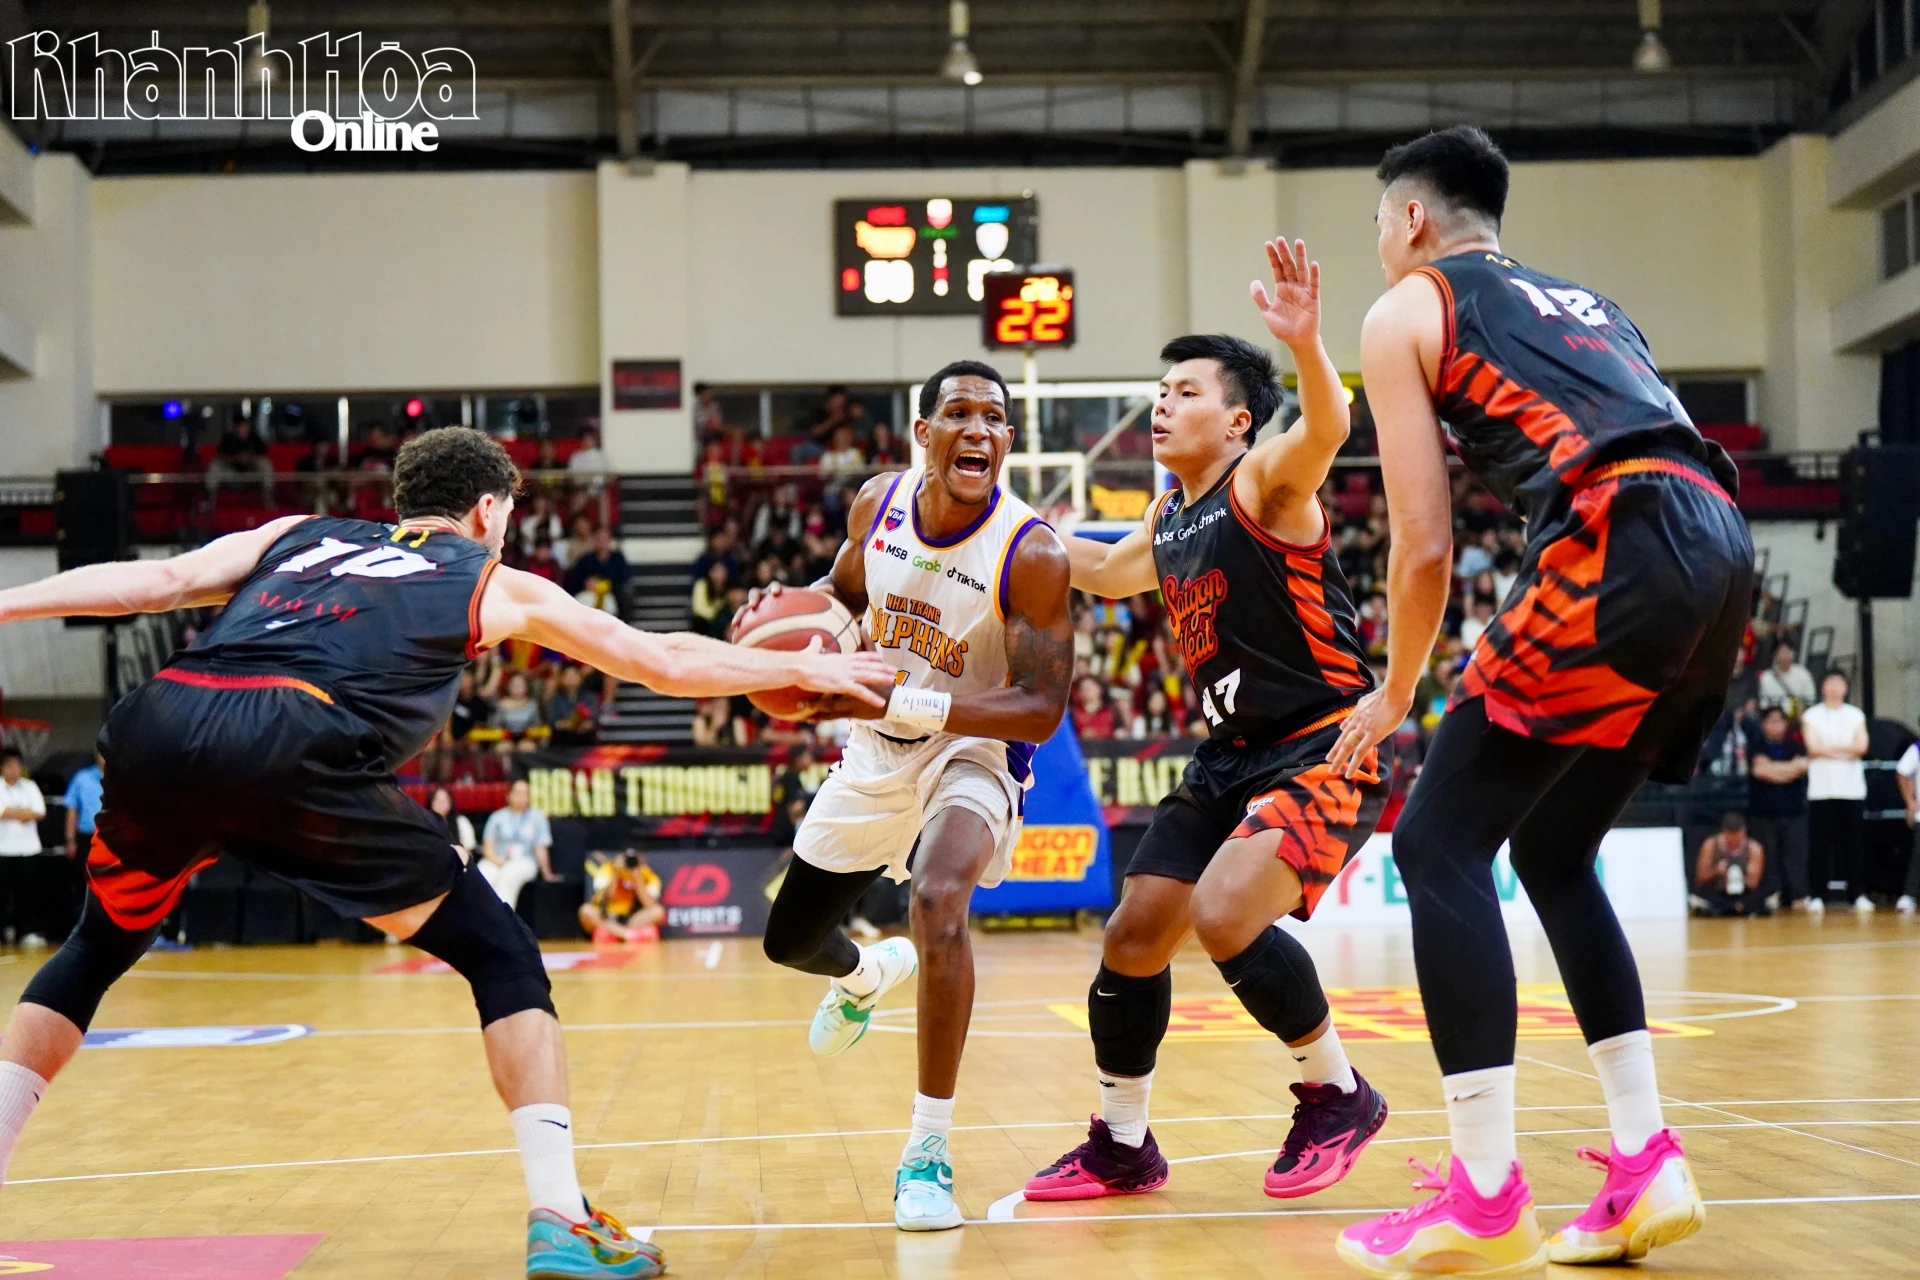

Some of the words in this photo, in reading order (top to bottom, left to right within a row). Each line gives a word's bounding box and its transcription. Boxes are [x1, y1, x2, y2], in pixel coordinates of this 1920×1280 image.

[997, 298, 1070, 342] 22
[1508, 277, 1610, 327] 12
[888, 509, 904, 521] VBA
[274, 536, 437, 577] 10
[885, 544, 908, 560] MSB
[911, 555, 942, 573] Grab
[956, 571, 987, 593] TikTok
[885, 593, 908, 613] NHA
[908, 598, 942, 625] TRANG
[1164, 570, 1227, 641] Saigon
[1202, 668, 1241, 728] 47
